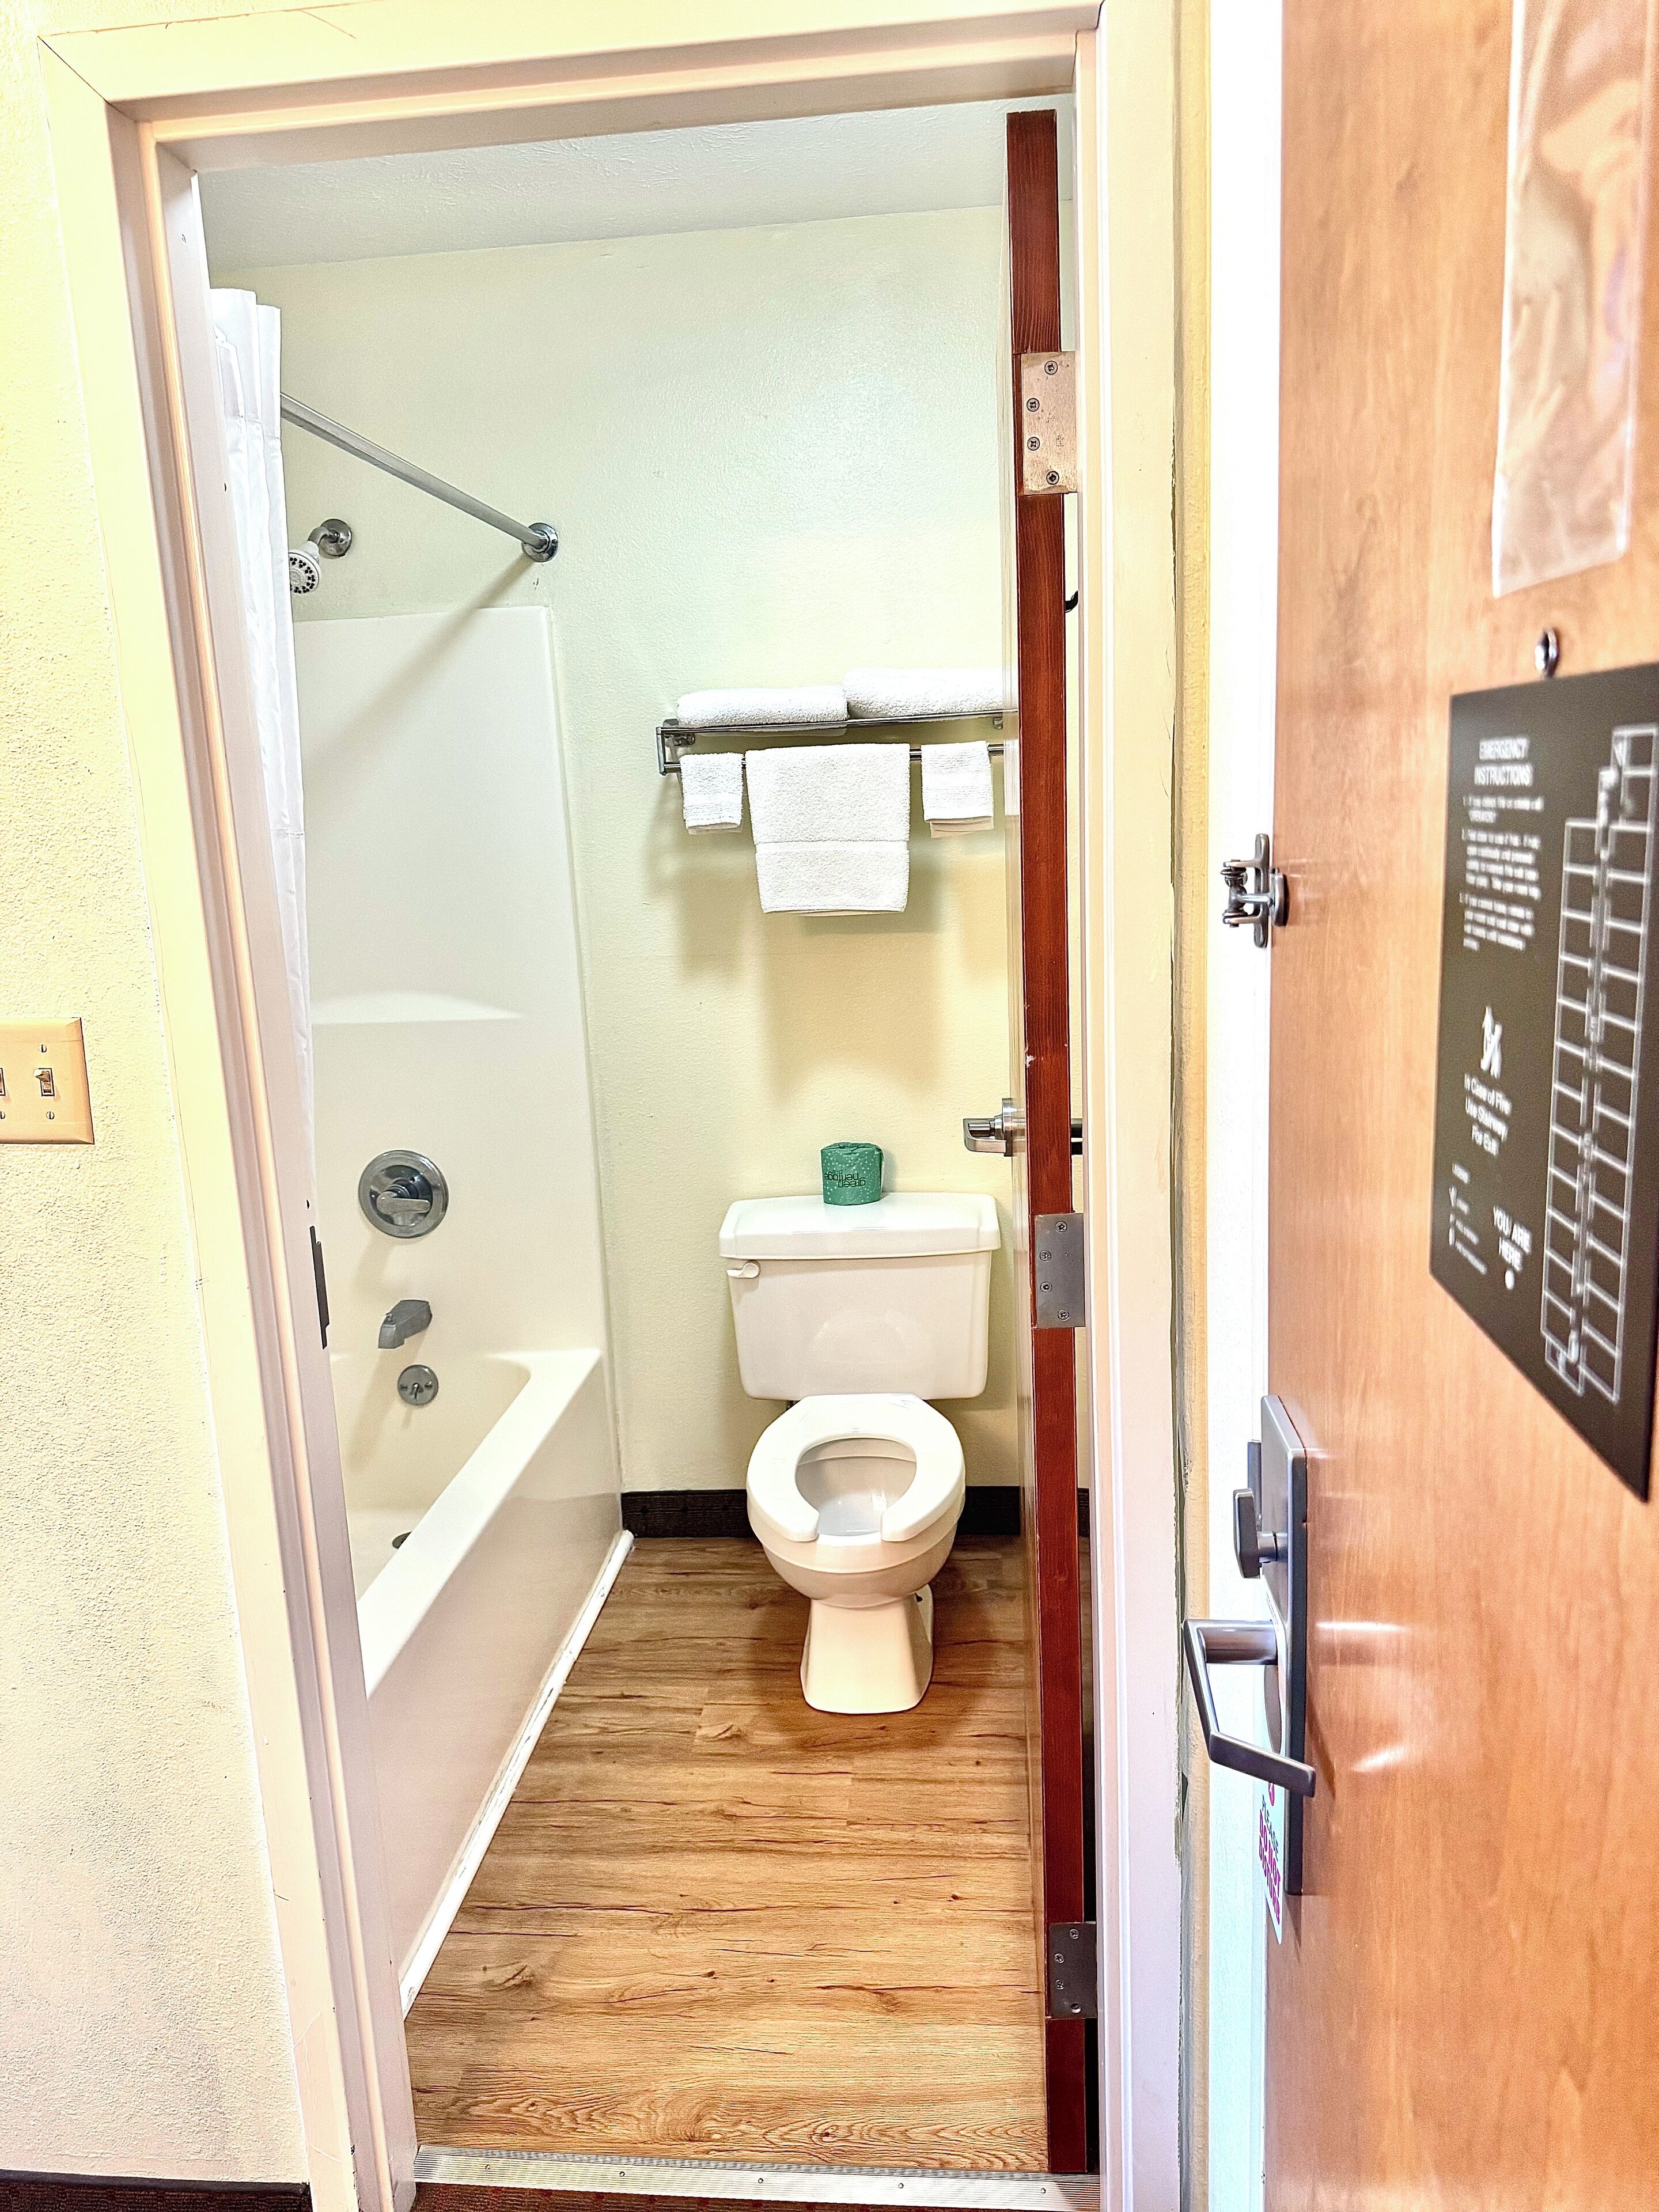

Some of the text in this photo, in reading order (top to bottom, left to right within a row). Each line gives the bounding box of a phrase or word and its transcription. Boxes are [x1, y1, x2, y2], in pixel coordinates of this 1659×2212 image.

[1479, 738, 1529, 760] EMERGENCY
[1474, 764, 1533, 787] INSTRUCTIONS
[1464, 1073, 1471, 1092] In
[1487, 1089, 1495, 1107] of
[824, 1171, 858, 1184] heritage
[837, 1177, 866, 1188] green
[1493, 1205, 1512, 1237] YOU
[1512, 1223, 1532, 1255] ARE
[1498, 1236, 1523, 1272] HERE
[1262, 1794, 1279, 1862] PLEASE
[1259, 1809, 1281, 1898] DO NOT
[1259, 1835, 1280, 1925] DISTURB
